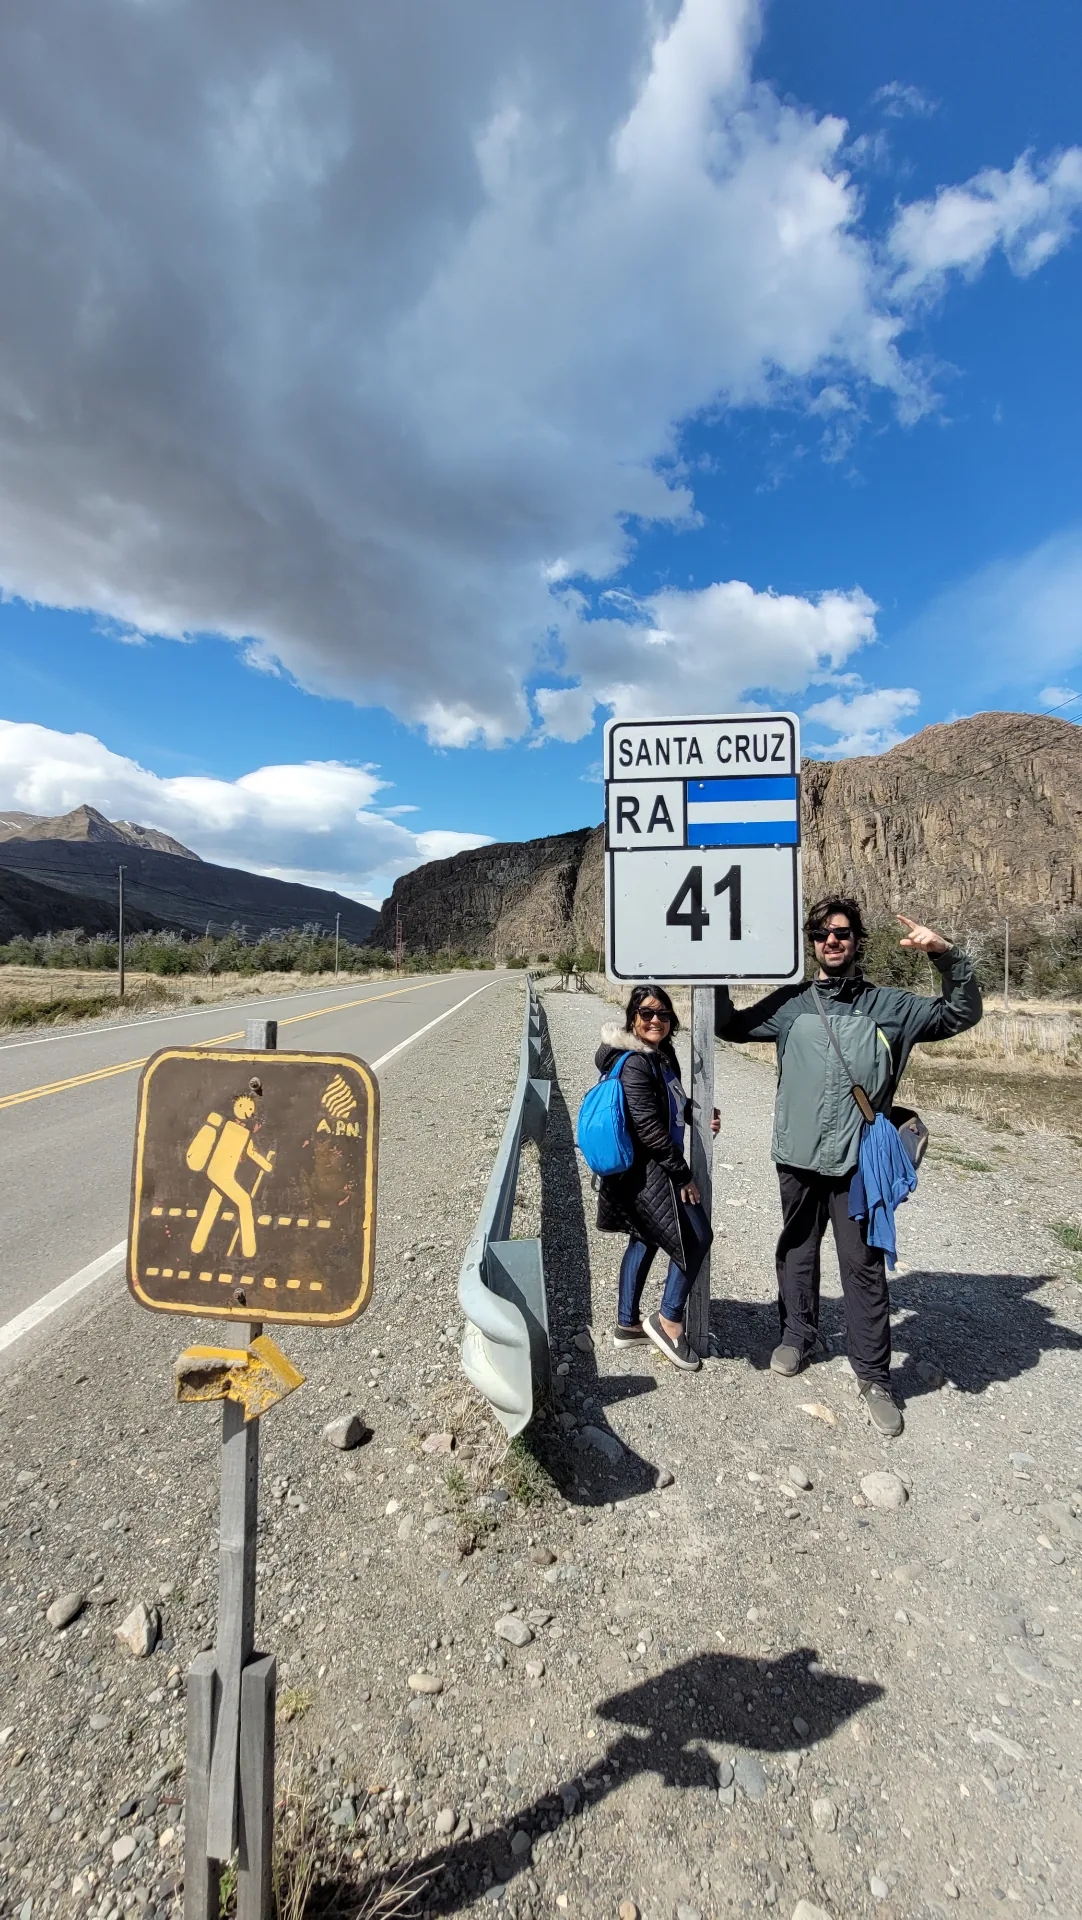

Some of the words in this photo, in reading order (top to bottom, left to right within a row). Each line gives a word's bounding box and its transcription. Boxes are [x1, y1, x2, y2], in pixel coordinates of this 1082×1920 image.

[619, 737, 704, 767] SANTA
[716, 733, 785, 764] CRUZ
[616, 795, 675, 834] RA
[666, 864, 742, 941] 41
